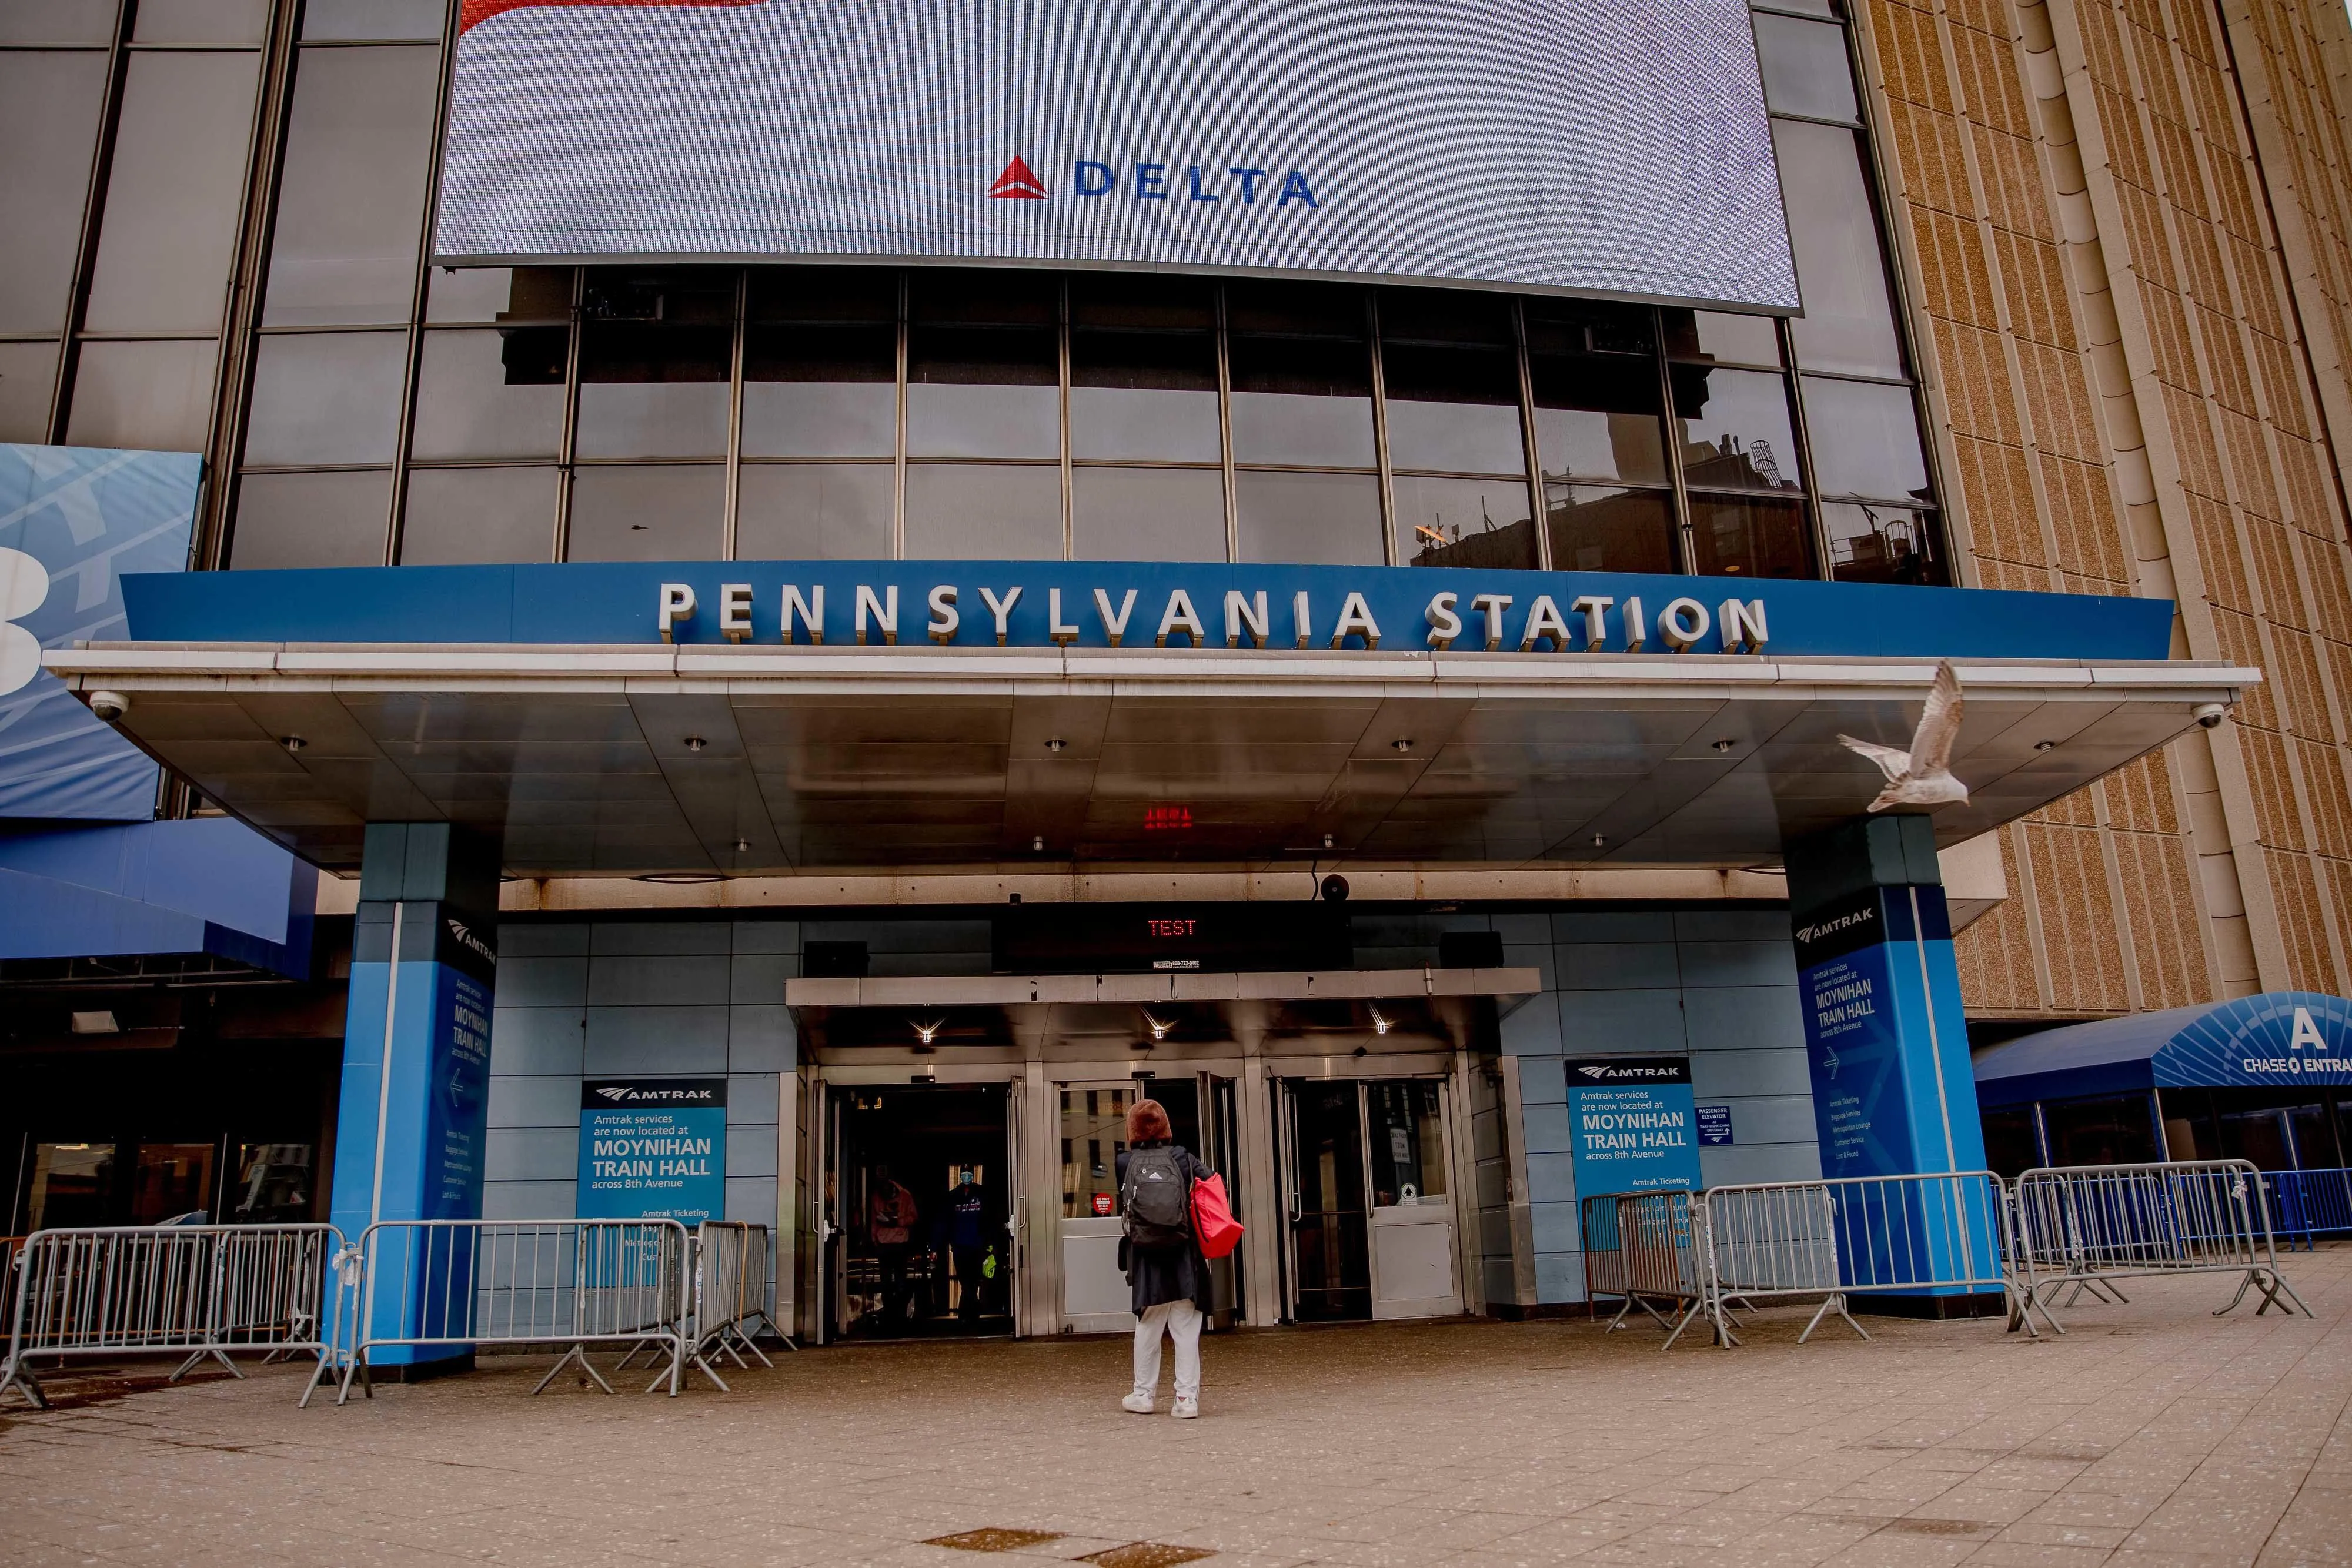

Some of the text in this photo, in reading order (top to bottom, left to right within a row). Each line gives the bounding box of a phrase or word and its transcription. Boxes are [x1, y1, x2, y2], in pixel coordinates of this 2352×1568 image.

[1075, 160, 1318, 208] DELTA
[659, 583, 1769, 653] PENNSYLVANIA STATION
[1148, 920, 1195, 935] TEST
[1813, 907, 1873, 939] AMTRAK
[465, 934, 496, 965] AMTRAK
[1813, 962, 1847, 981] Amtrak services
[1822, 979, 1832, 989] now
[1832, 972, 1850, 985] located
[1851, 971, 1857, 979] at
[1816, 978, 1872, 1009] MOYNIHAN
[454, 1004, 489, 1038] MOYNIHAN
[1818, 999, 1875, 1028] TRAIN HALL
[1820, 1021, 1862, 1038] across 8th Avenue
[2291, 1007, 2328, 1049] A
[453, 1027, 487, 1058] TRAIN HALL
[1606, 1067, 1679, 1077] AMTRAK
[2243, 1058, 2352, 1072] CHASE ENTRA
[627, 1090, 712, 1100] AMTRAK
[1581, 1091, 1648, 1101] Amtrak services
[1620, 1101, 1652, 1110] located
[594, 1114, 673, 1124] Amtrak services
[1583, 1112, 1684, 1131] MOYNIHAN
[639, 1126, 675, 1135] located
[678, 1126, 688, 1134] at
[594, 1138, 711, 1156] MOYNIHAN
[1583, 1131, 1686, 1149] TRAIN HALL
[1586, 1150, 1665, 1160] across 8th Avenue
[592, 1159, 710, 1177] TRAIN HALL
[592, 1179, 683, 1189] across 8th Avenue
[642, 1209, 709, 1218] Amtrak Ticketing
